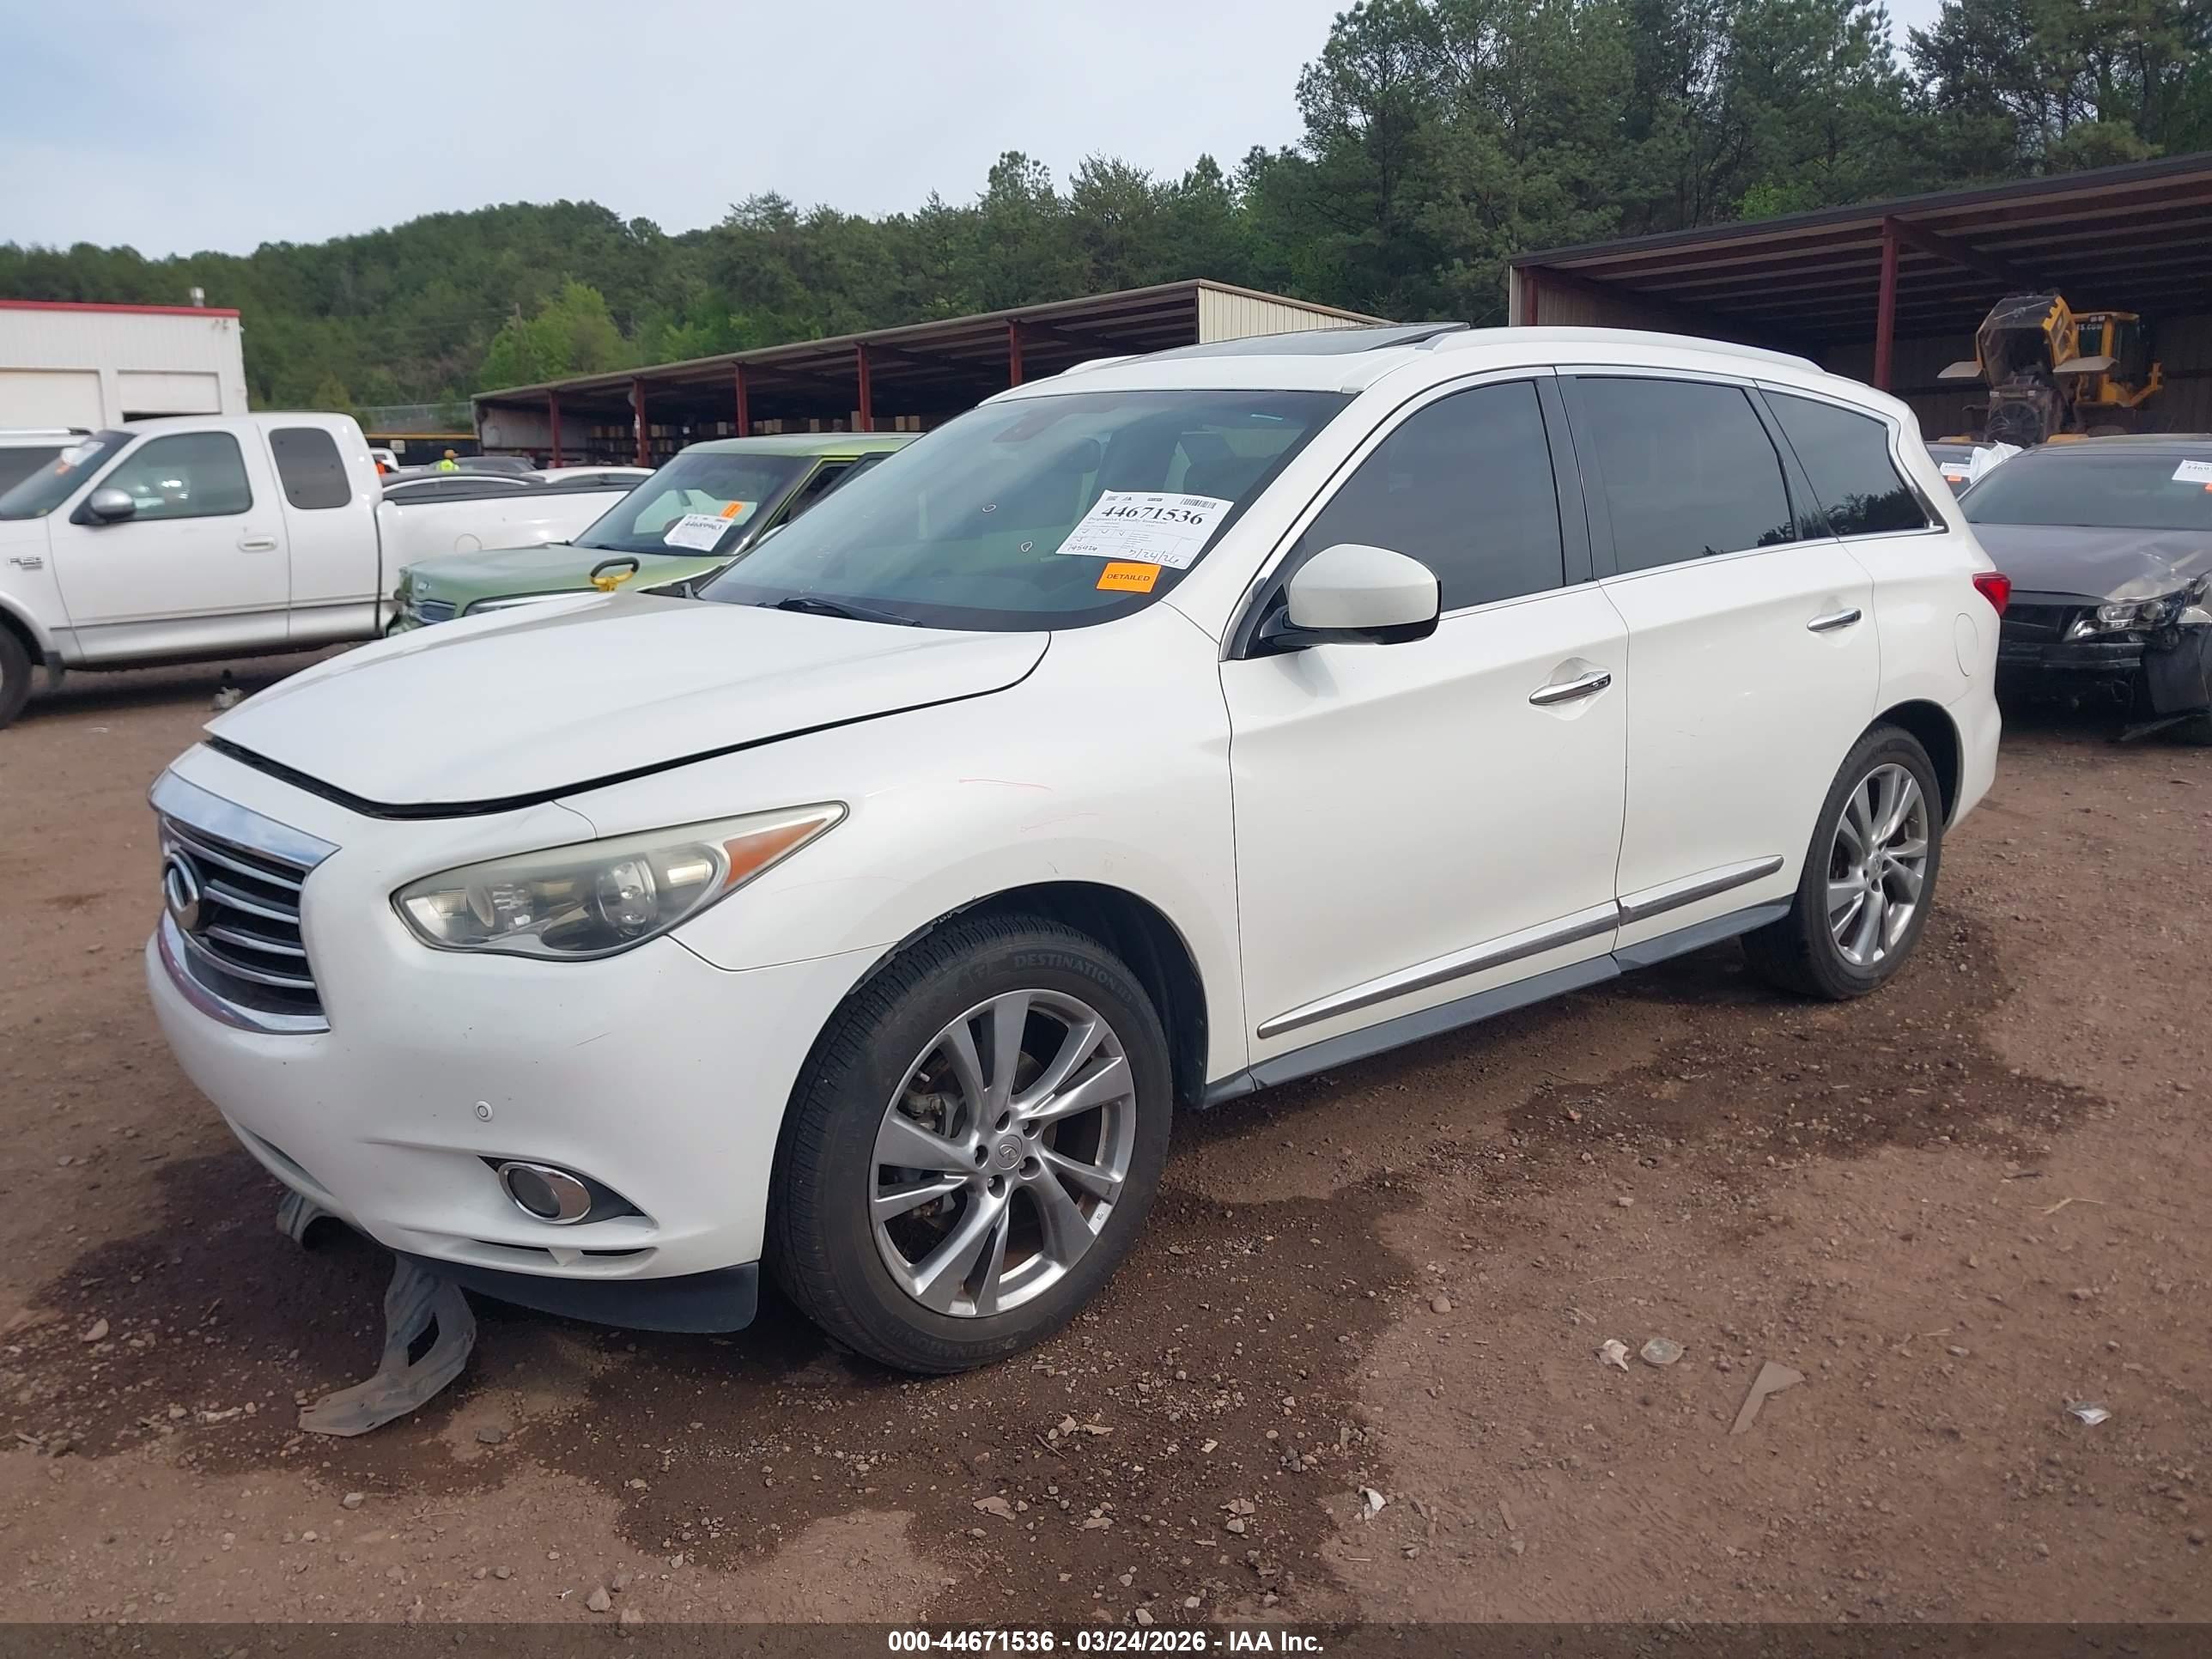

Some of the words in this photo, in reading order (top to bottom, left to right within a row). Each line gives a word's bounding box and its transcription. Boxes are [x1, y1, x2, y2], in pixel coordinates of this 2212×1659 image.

[1101, 504, 1207, 526] 44671536
[1106, 572, 1151, 582] DETAILED
[1013, 953, 1119, 991] DESTINATION
